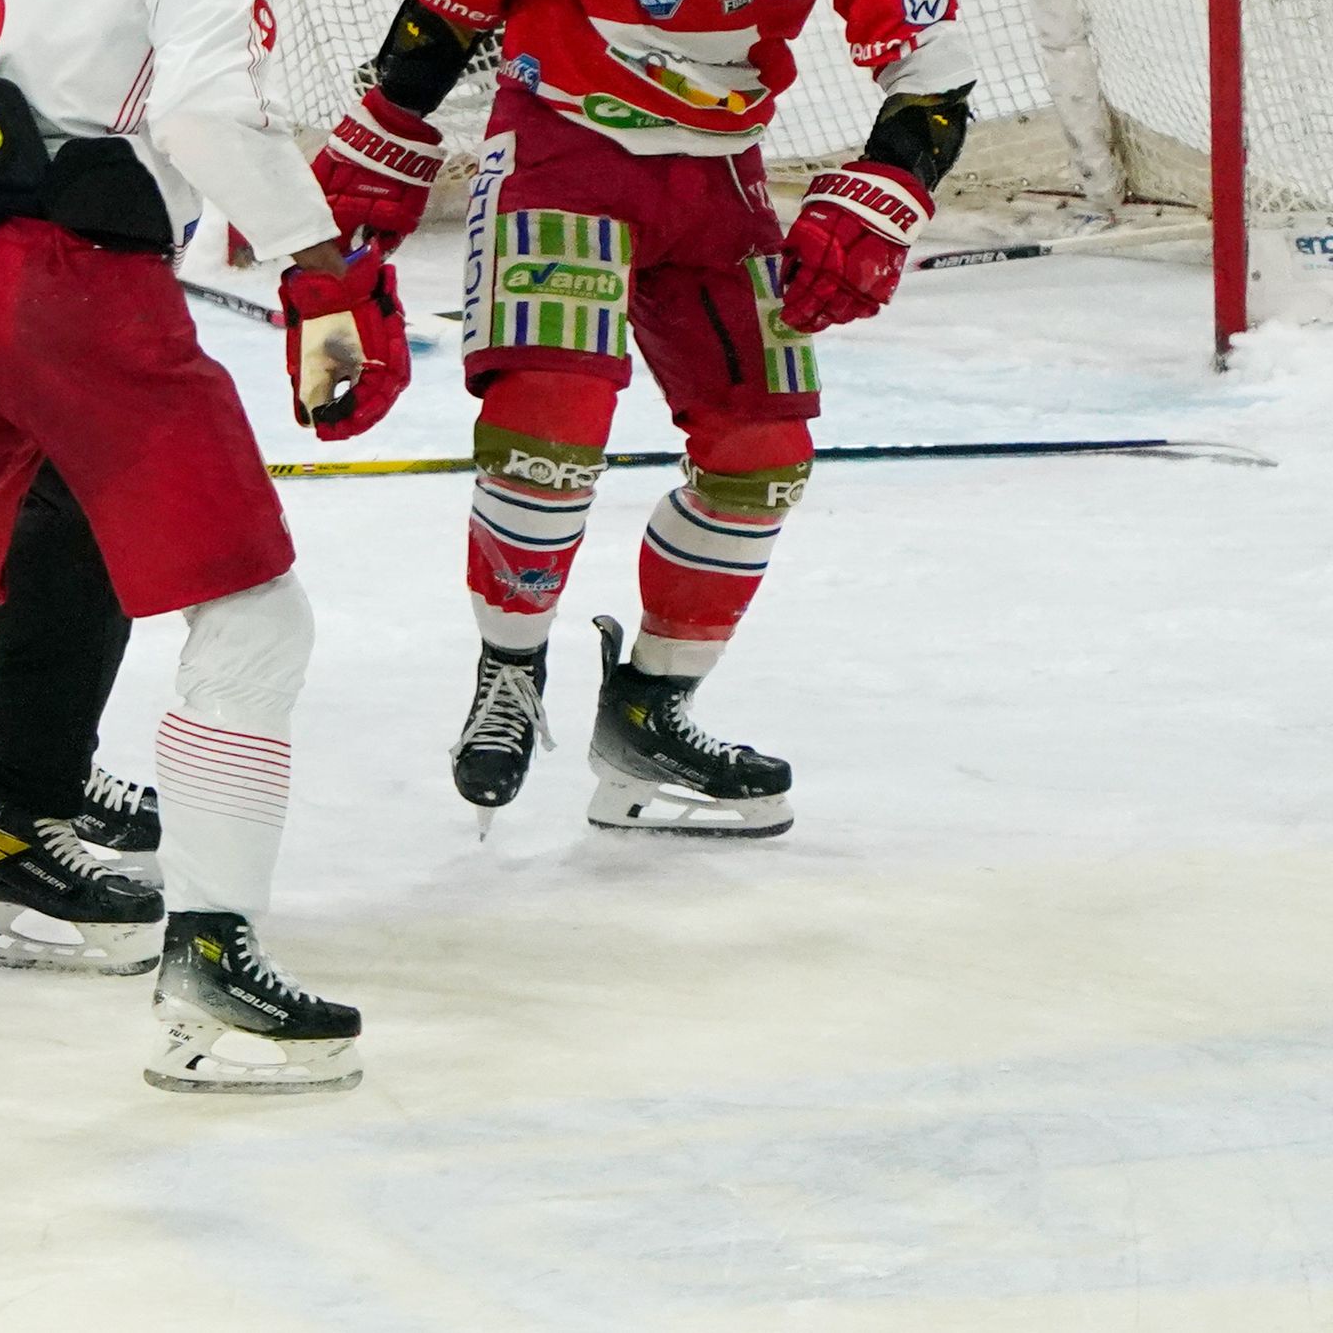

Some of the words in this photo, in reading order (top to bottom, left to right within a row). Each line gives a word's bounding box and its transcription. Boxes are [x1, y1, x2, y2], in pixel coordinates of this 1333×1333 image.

[506, 260, 619, 295] avanti
[22, 860, 69, 898] BAUER
[230, 985, 291, 1022] BAUER
